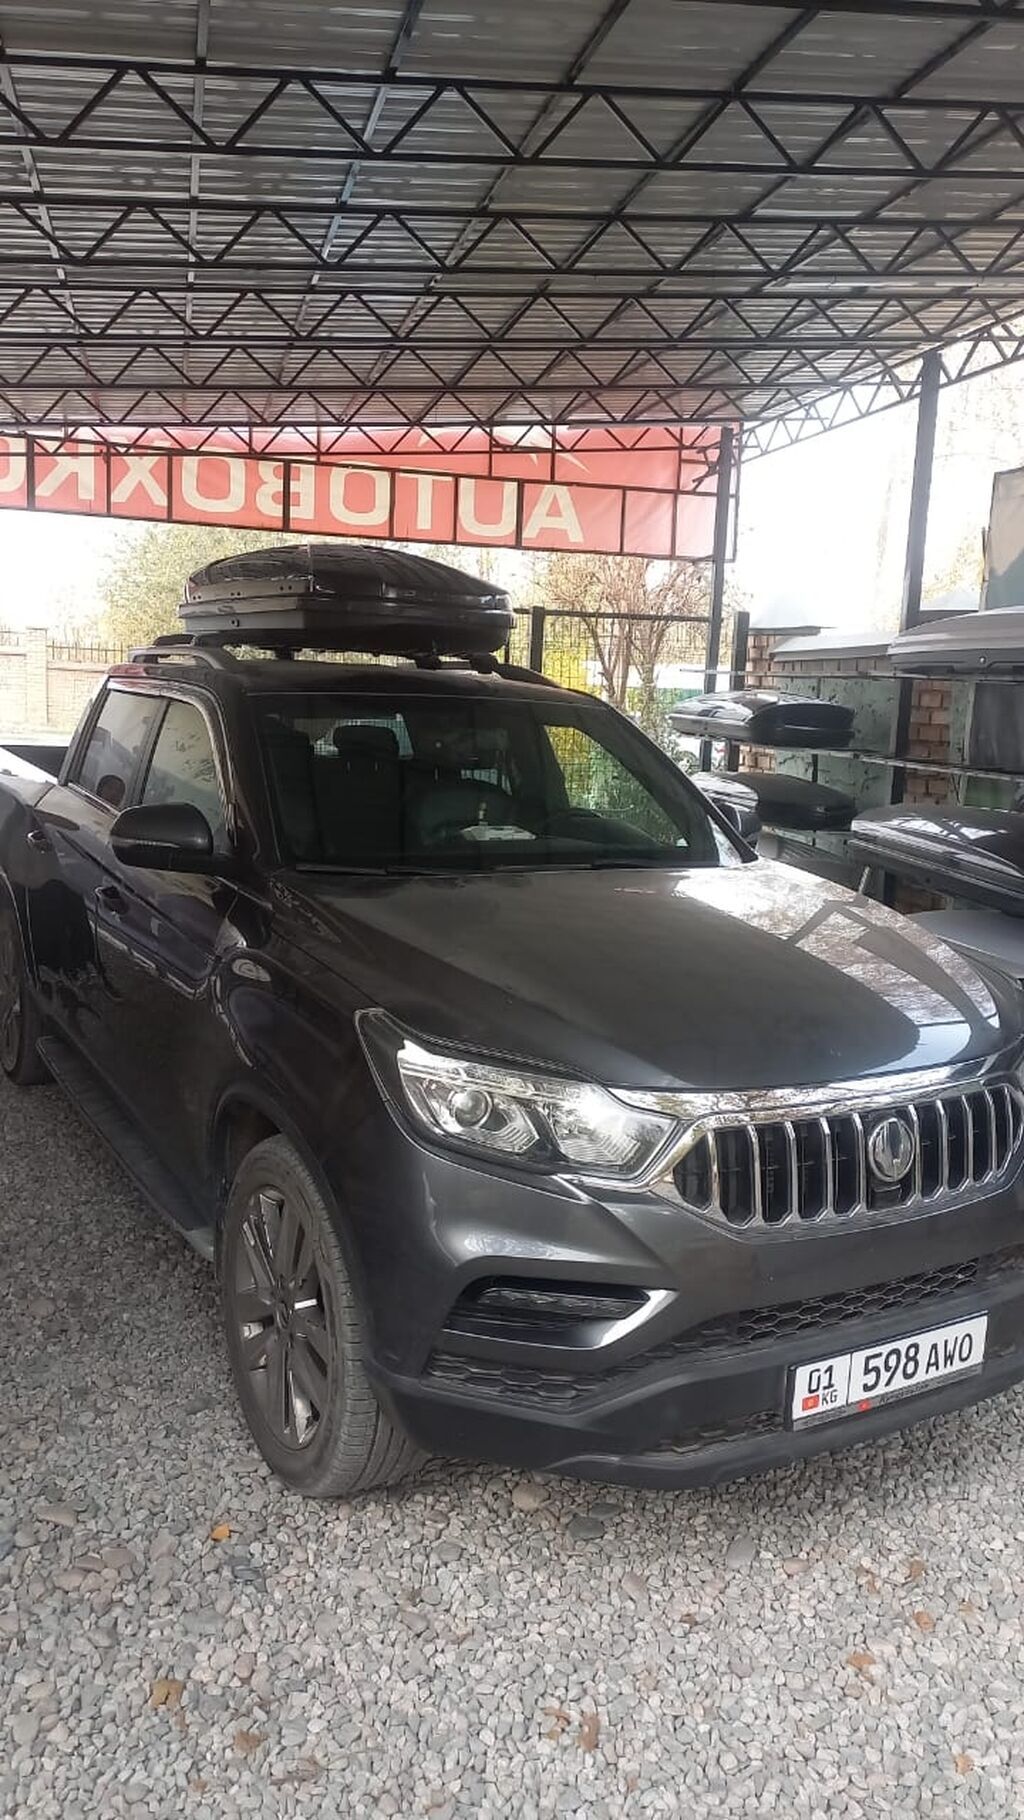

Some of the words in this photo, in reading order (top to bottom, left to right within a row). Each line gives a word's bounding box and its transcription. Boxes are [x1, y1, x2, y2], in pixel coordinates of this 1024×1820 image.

[808, 1364, 834, 1394] 01
[863, 1342, 919, 1393] 598
[925, 1333, 973, 1374] AWO
[821, 1389, 837, 1406] KG
